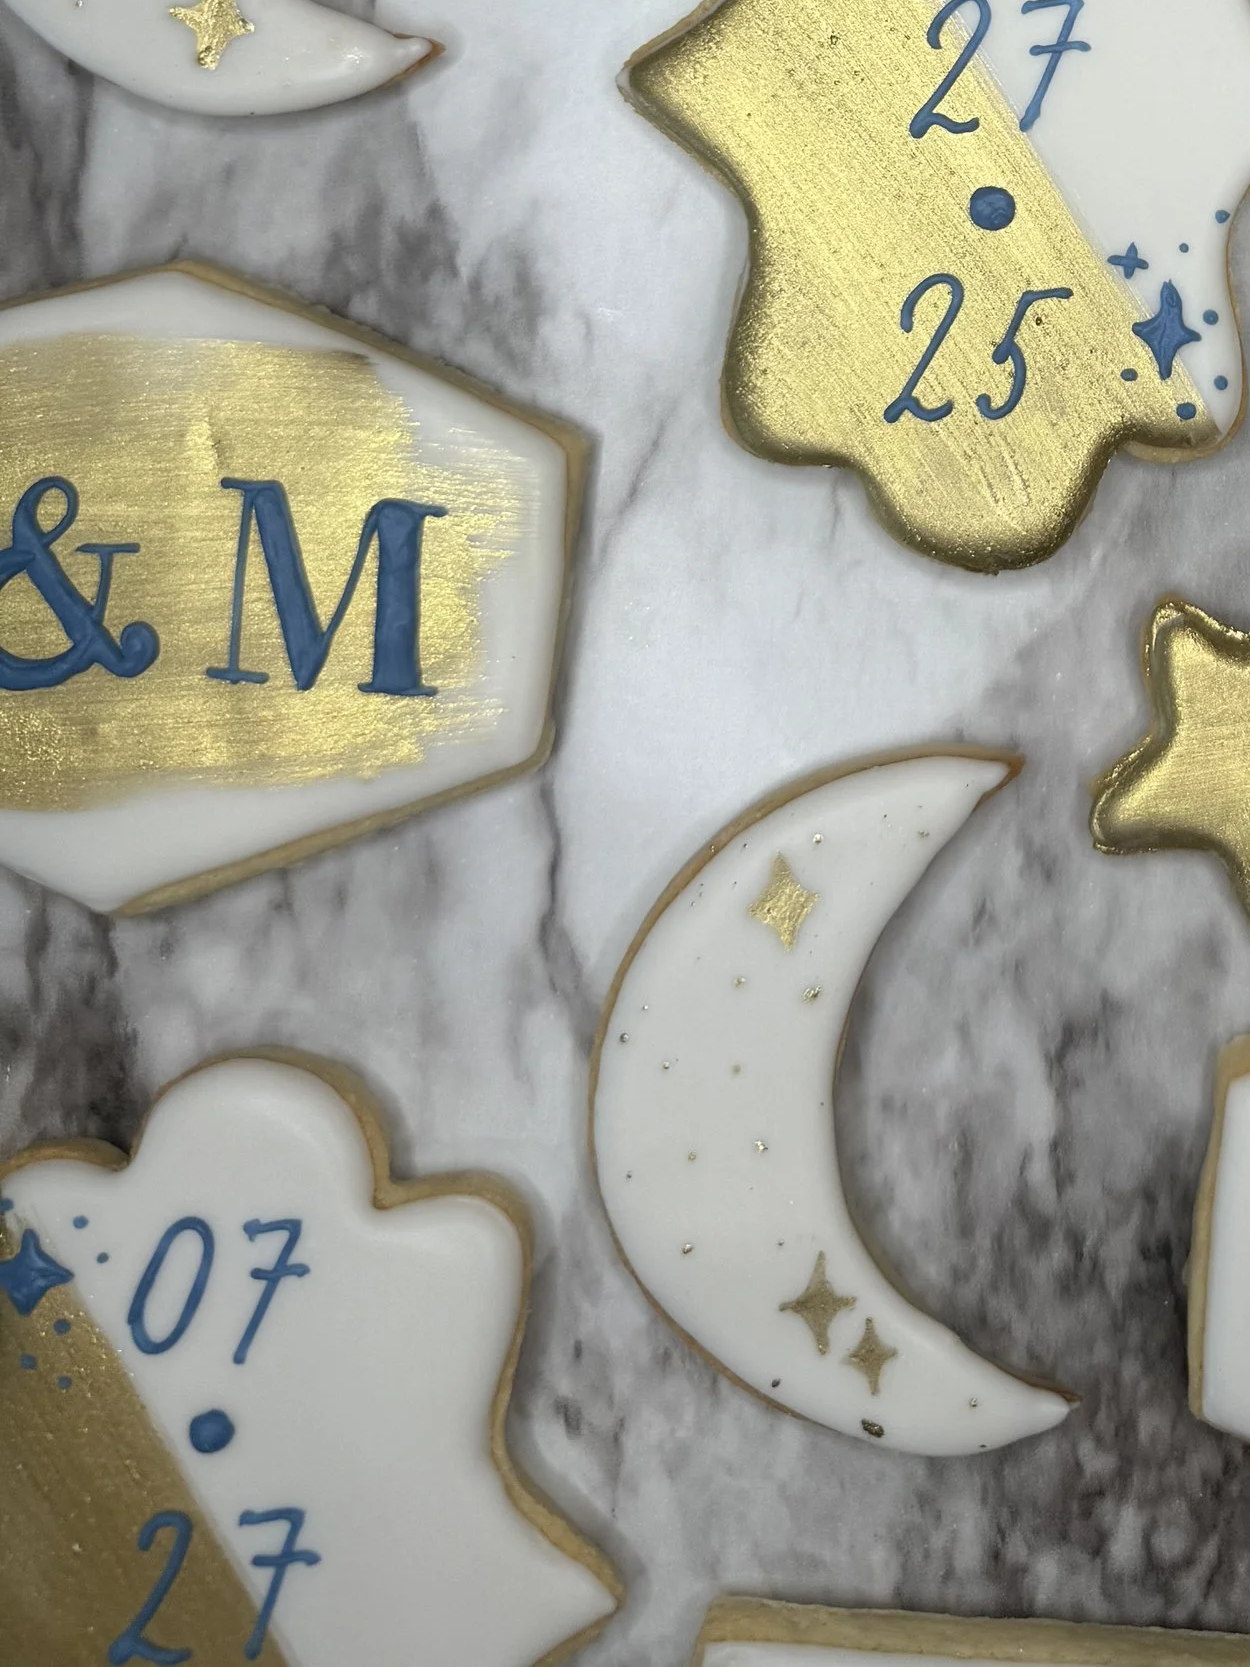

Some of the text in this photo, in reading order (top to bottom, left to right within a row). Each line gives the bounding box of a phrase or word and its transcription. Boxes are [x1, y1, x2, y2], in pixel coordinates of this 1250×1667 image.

[883, 272, 1073, 425] 25
[0, 474, 449, 698] & M
[125, 1215, 311, 1366] 07
[107, 1507, 322, 1667] 27
